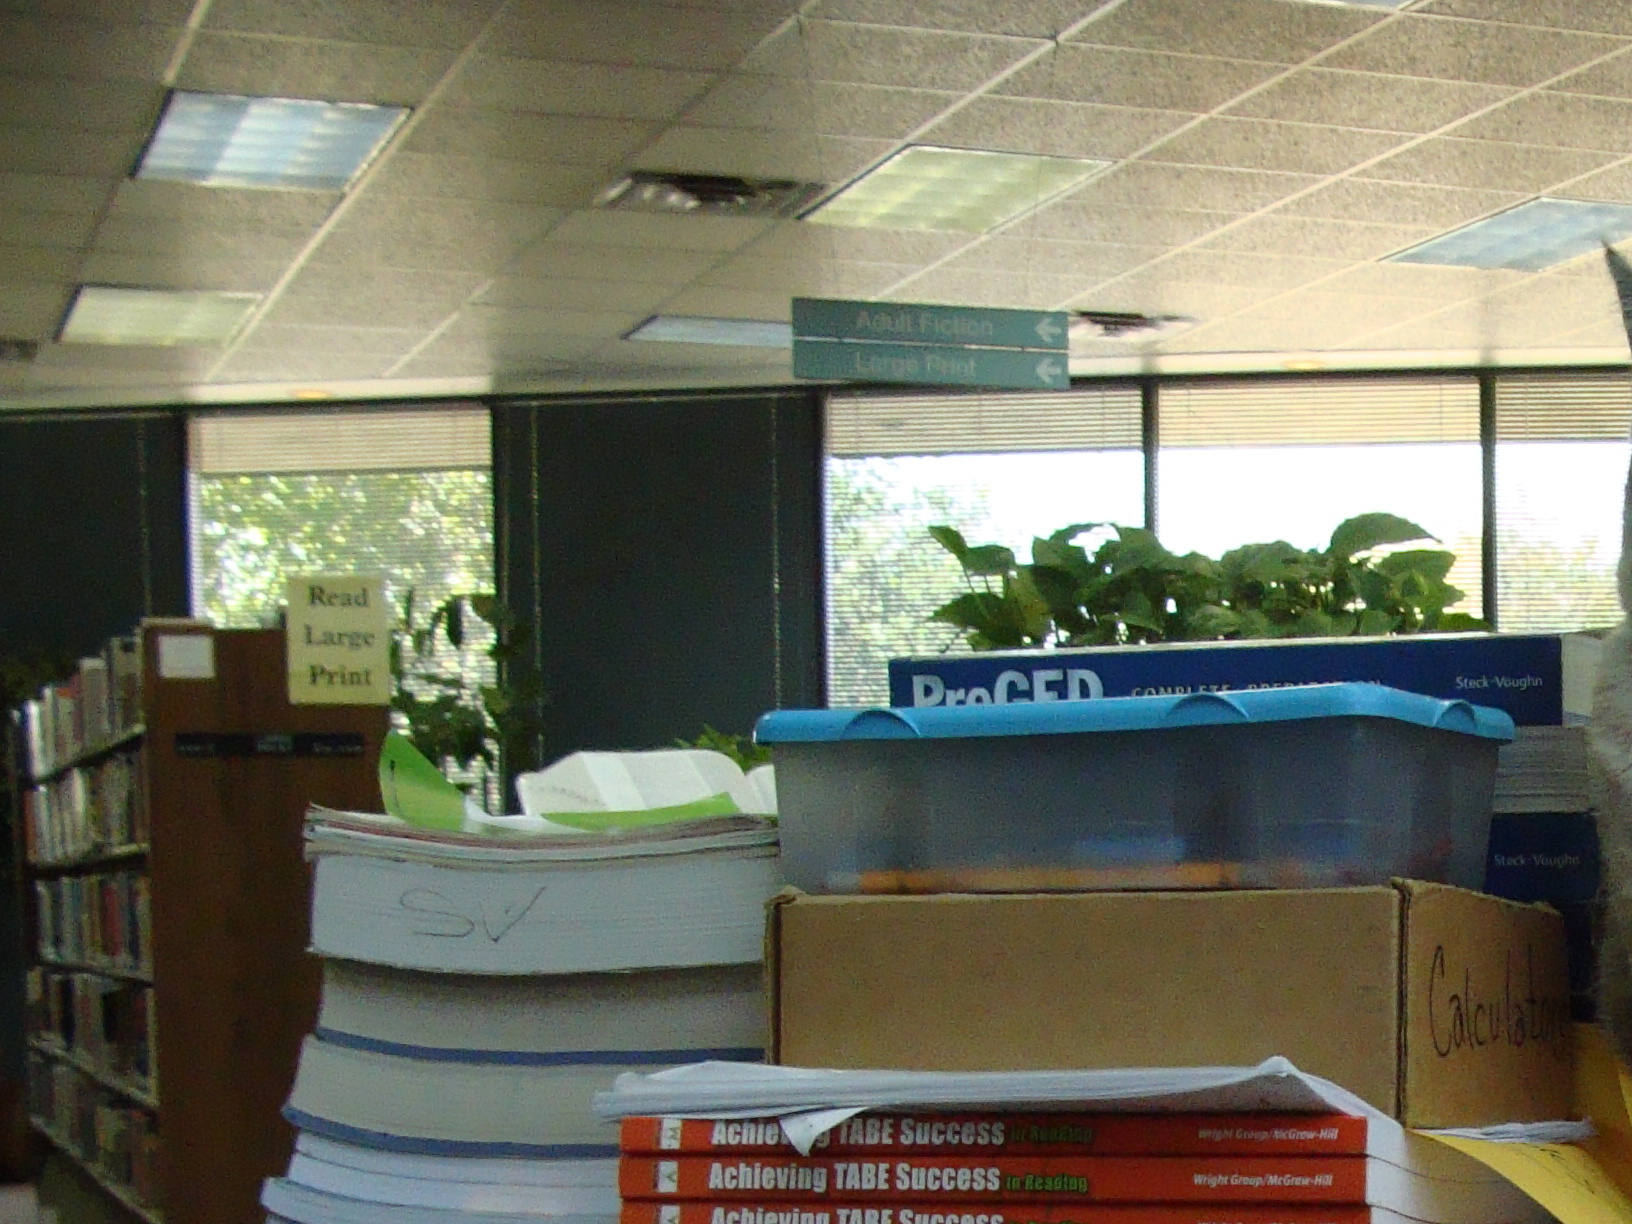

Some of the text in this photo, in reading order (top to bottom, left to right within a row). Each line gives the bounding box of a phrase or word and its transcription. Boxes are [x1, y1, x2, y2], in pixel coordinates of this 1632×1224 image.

[917, 312, 994, 336] Fiction
[308, 585, 369, 607] Read
[304, 624, 375, 649] Large
[309, 664, 371, 686] Print
[1456, 675, 1543, 691] Steck-Vaughn
[839, 1118, 893, 1145] TABE
[898, 1118, 1005, 1146] Success
[707, 1161, 1088, 1193] Achieving TABE Success in Reading
[1193, 1173, 1332, 1187] Wright Group/McGraw-Hill
